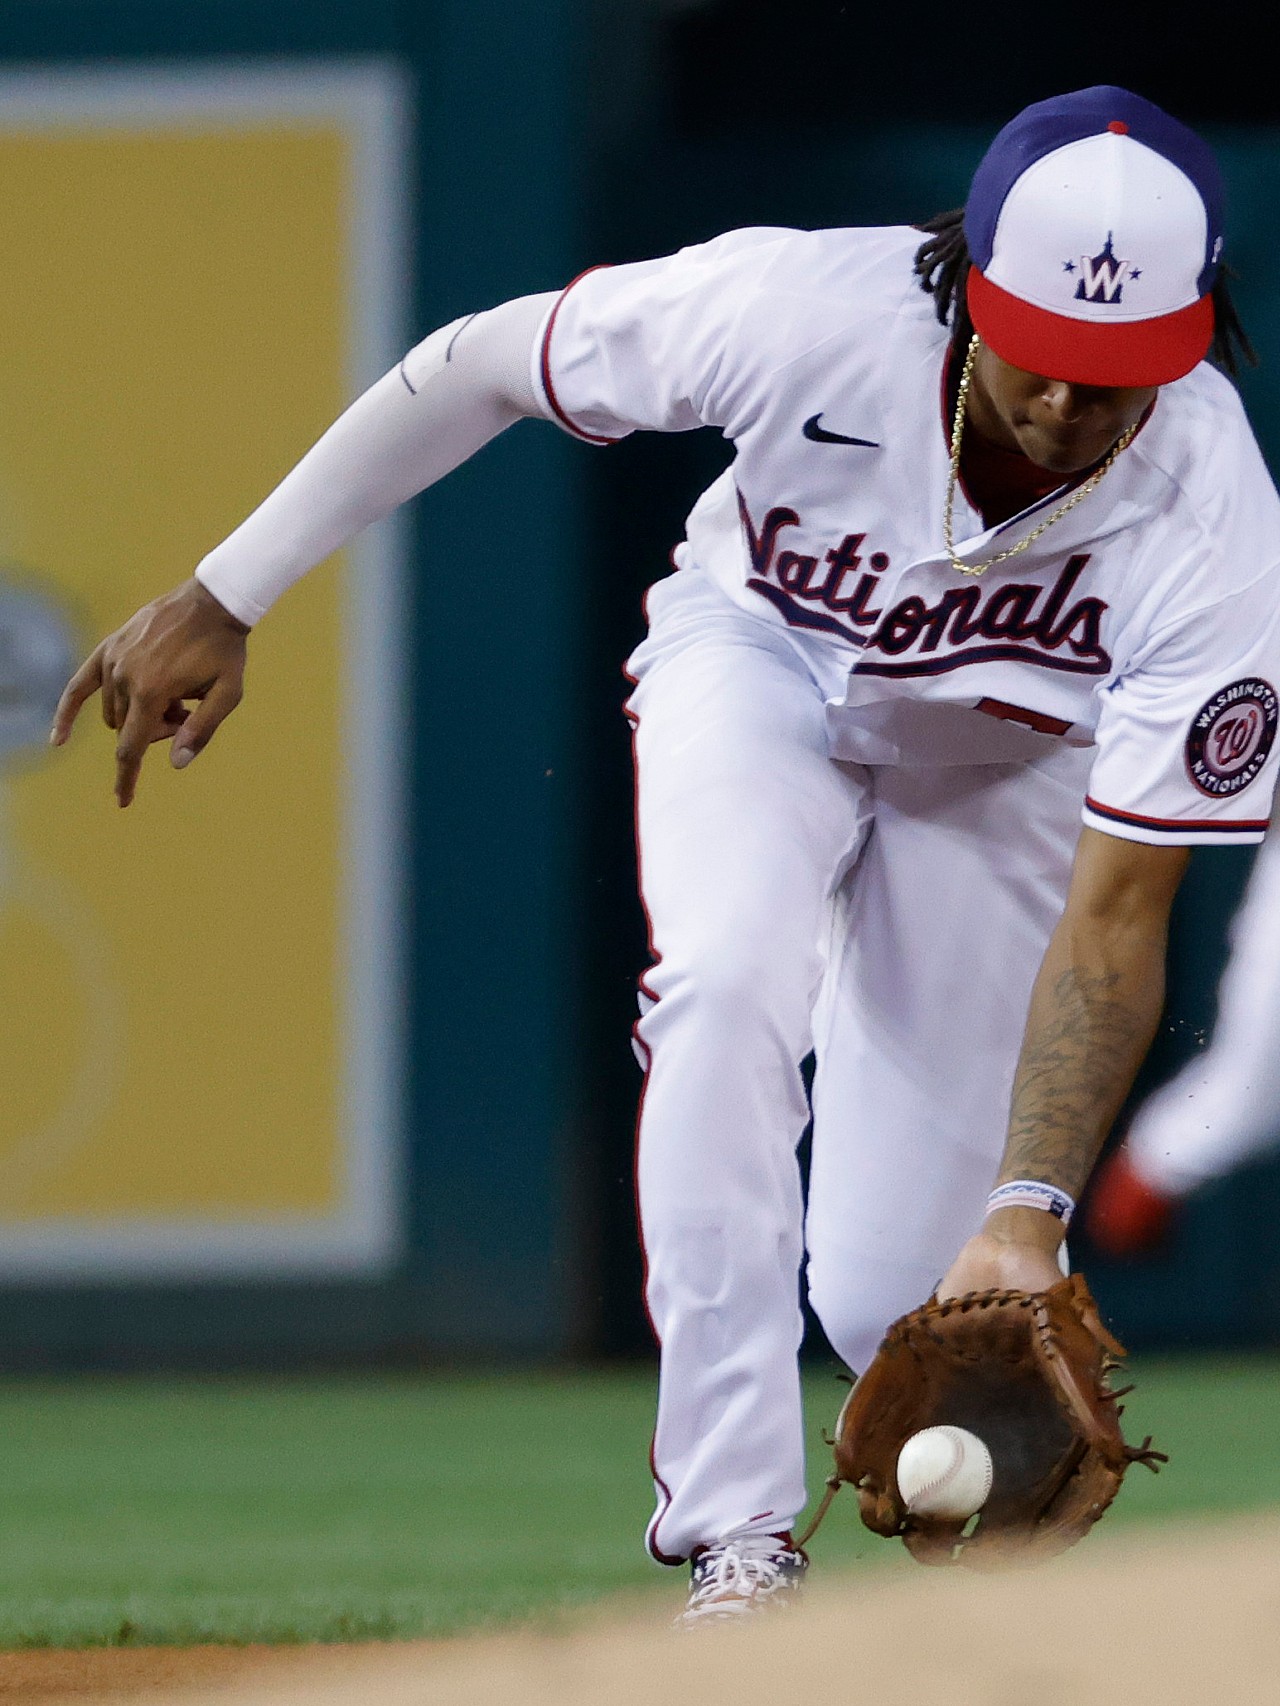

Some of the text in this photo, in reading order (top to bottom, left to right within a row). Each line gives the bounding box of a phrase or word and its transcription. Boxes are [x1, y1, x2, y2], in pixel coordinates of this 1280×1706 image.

[1081, 255, 1130, 302] W
[738, 487, 1110, 658] Nationals
[1195, 683, 1277, 728] WASHINGTON
[1191, 753, 1265, 792] NATIONALS
